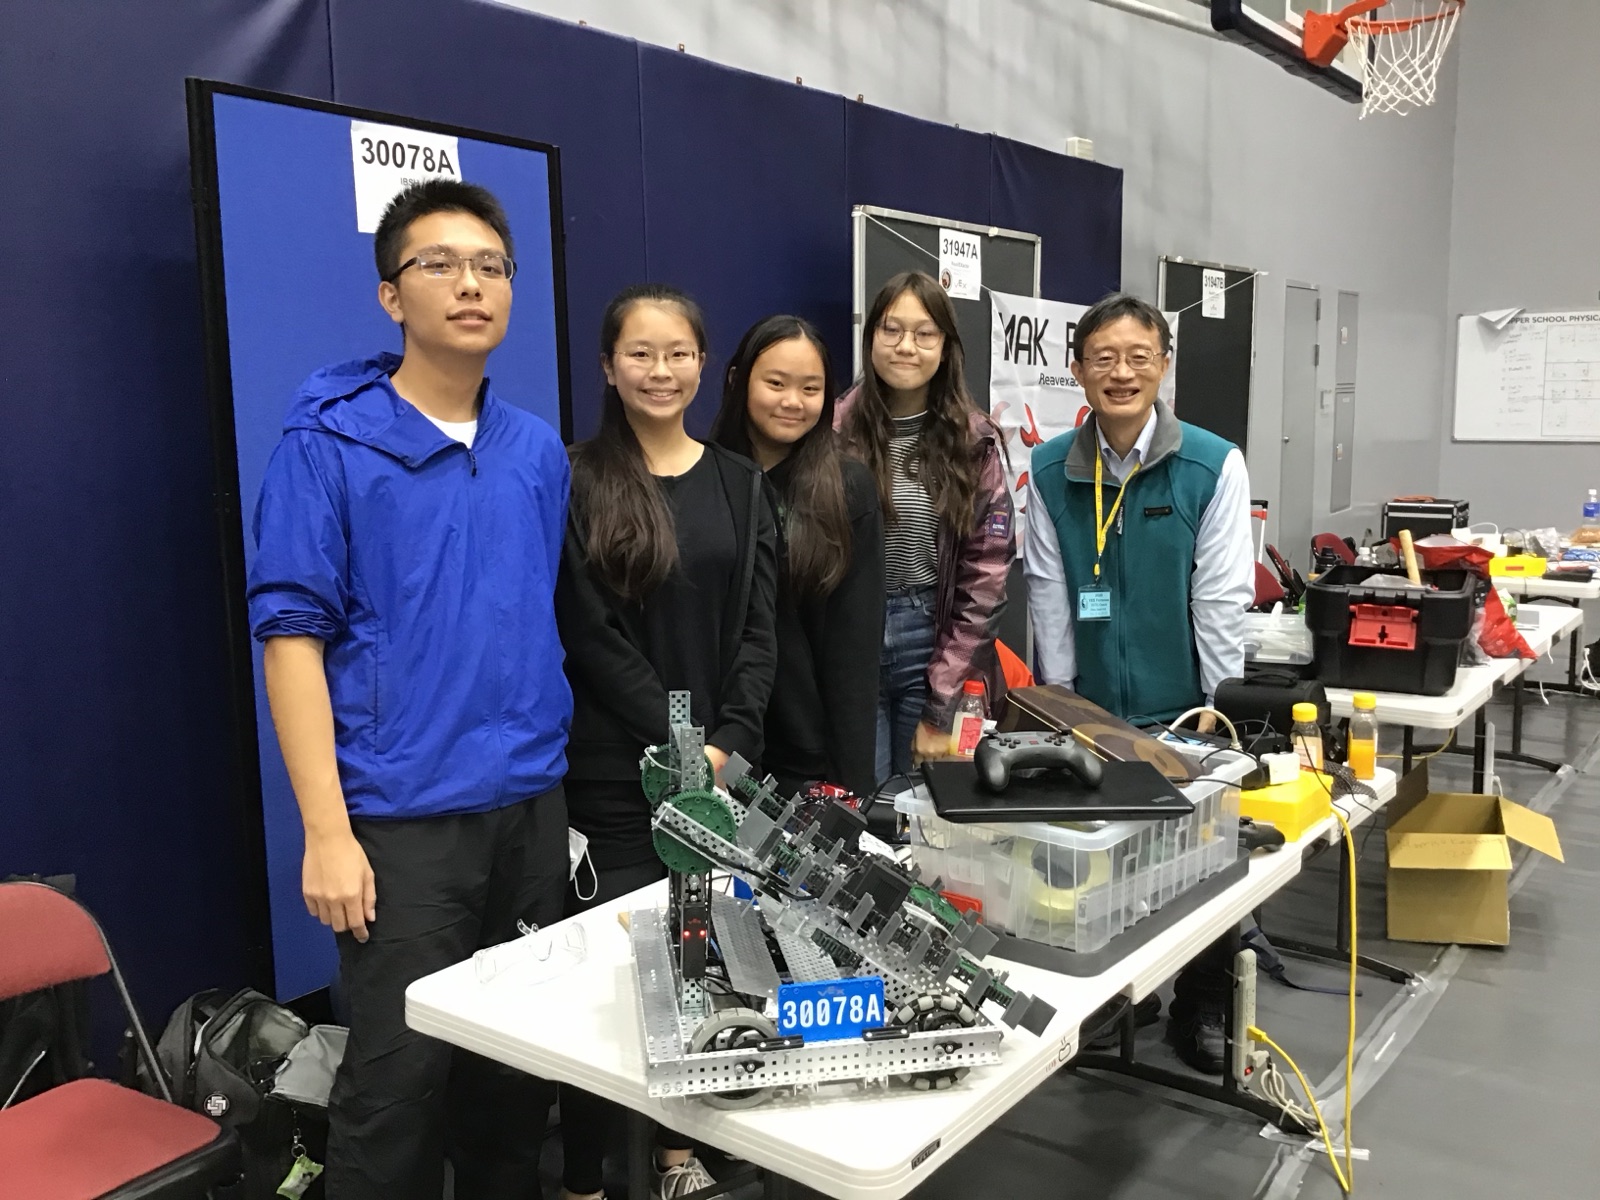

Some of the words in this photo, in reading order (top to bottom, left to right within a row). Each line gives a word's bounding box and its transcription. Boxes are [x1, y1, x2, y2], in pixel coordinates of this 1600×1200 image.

[360, 137, 455, 175] 30078A
[942, 238, 978, 260] 31947A
[1204, 274, 1224, 289] 31947B
[1569, 314, 1600, 322] PHYSIC
[782, 993, 881, 1029] 30078A
